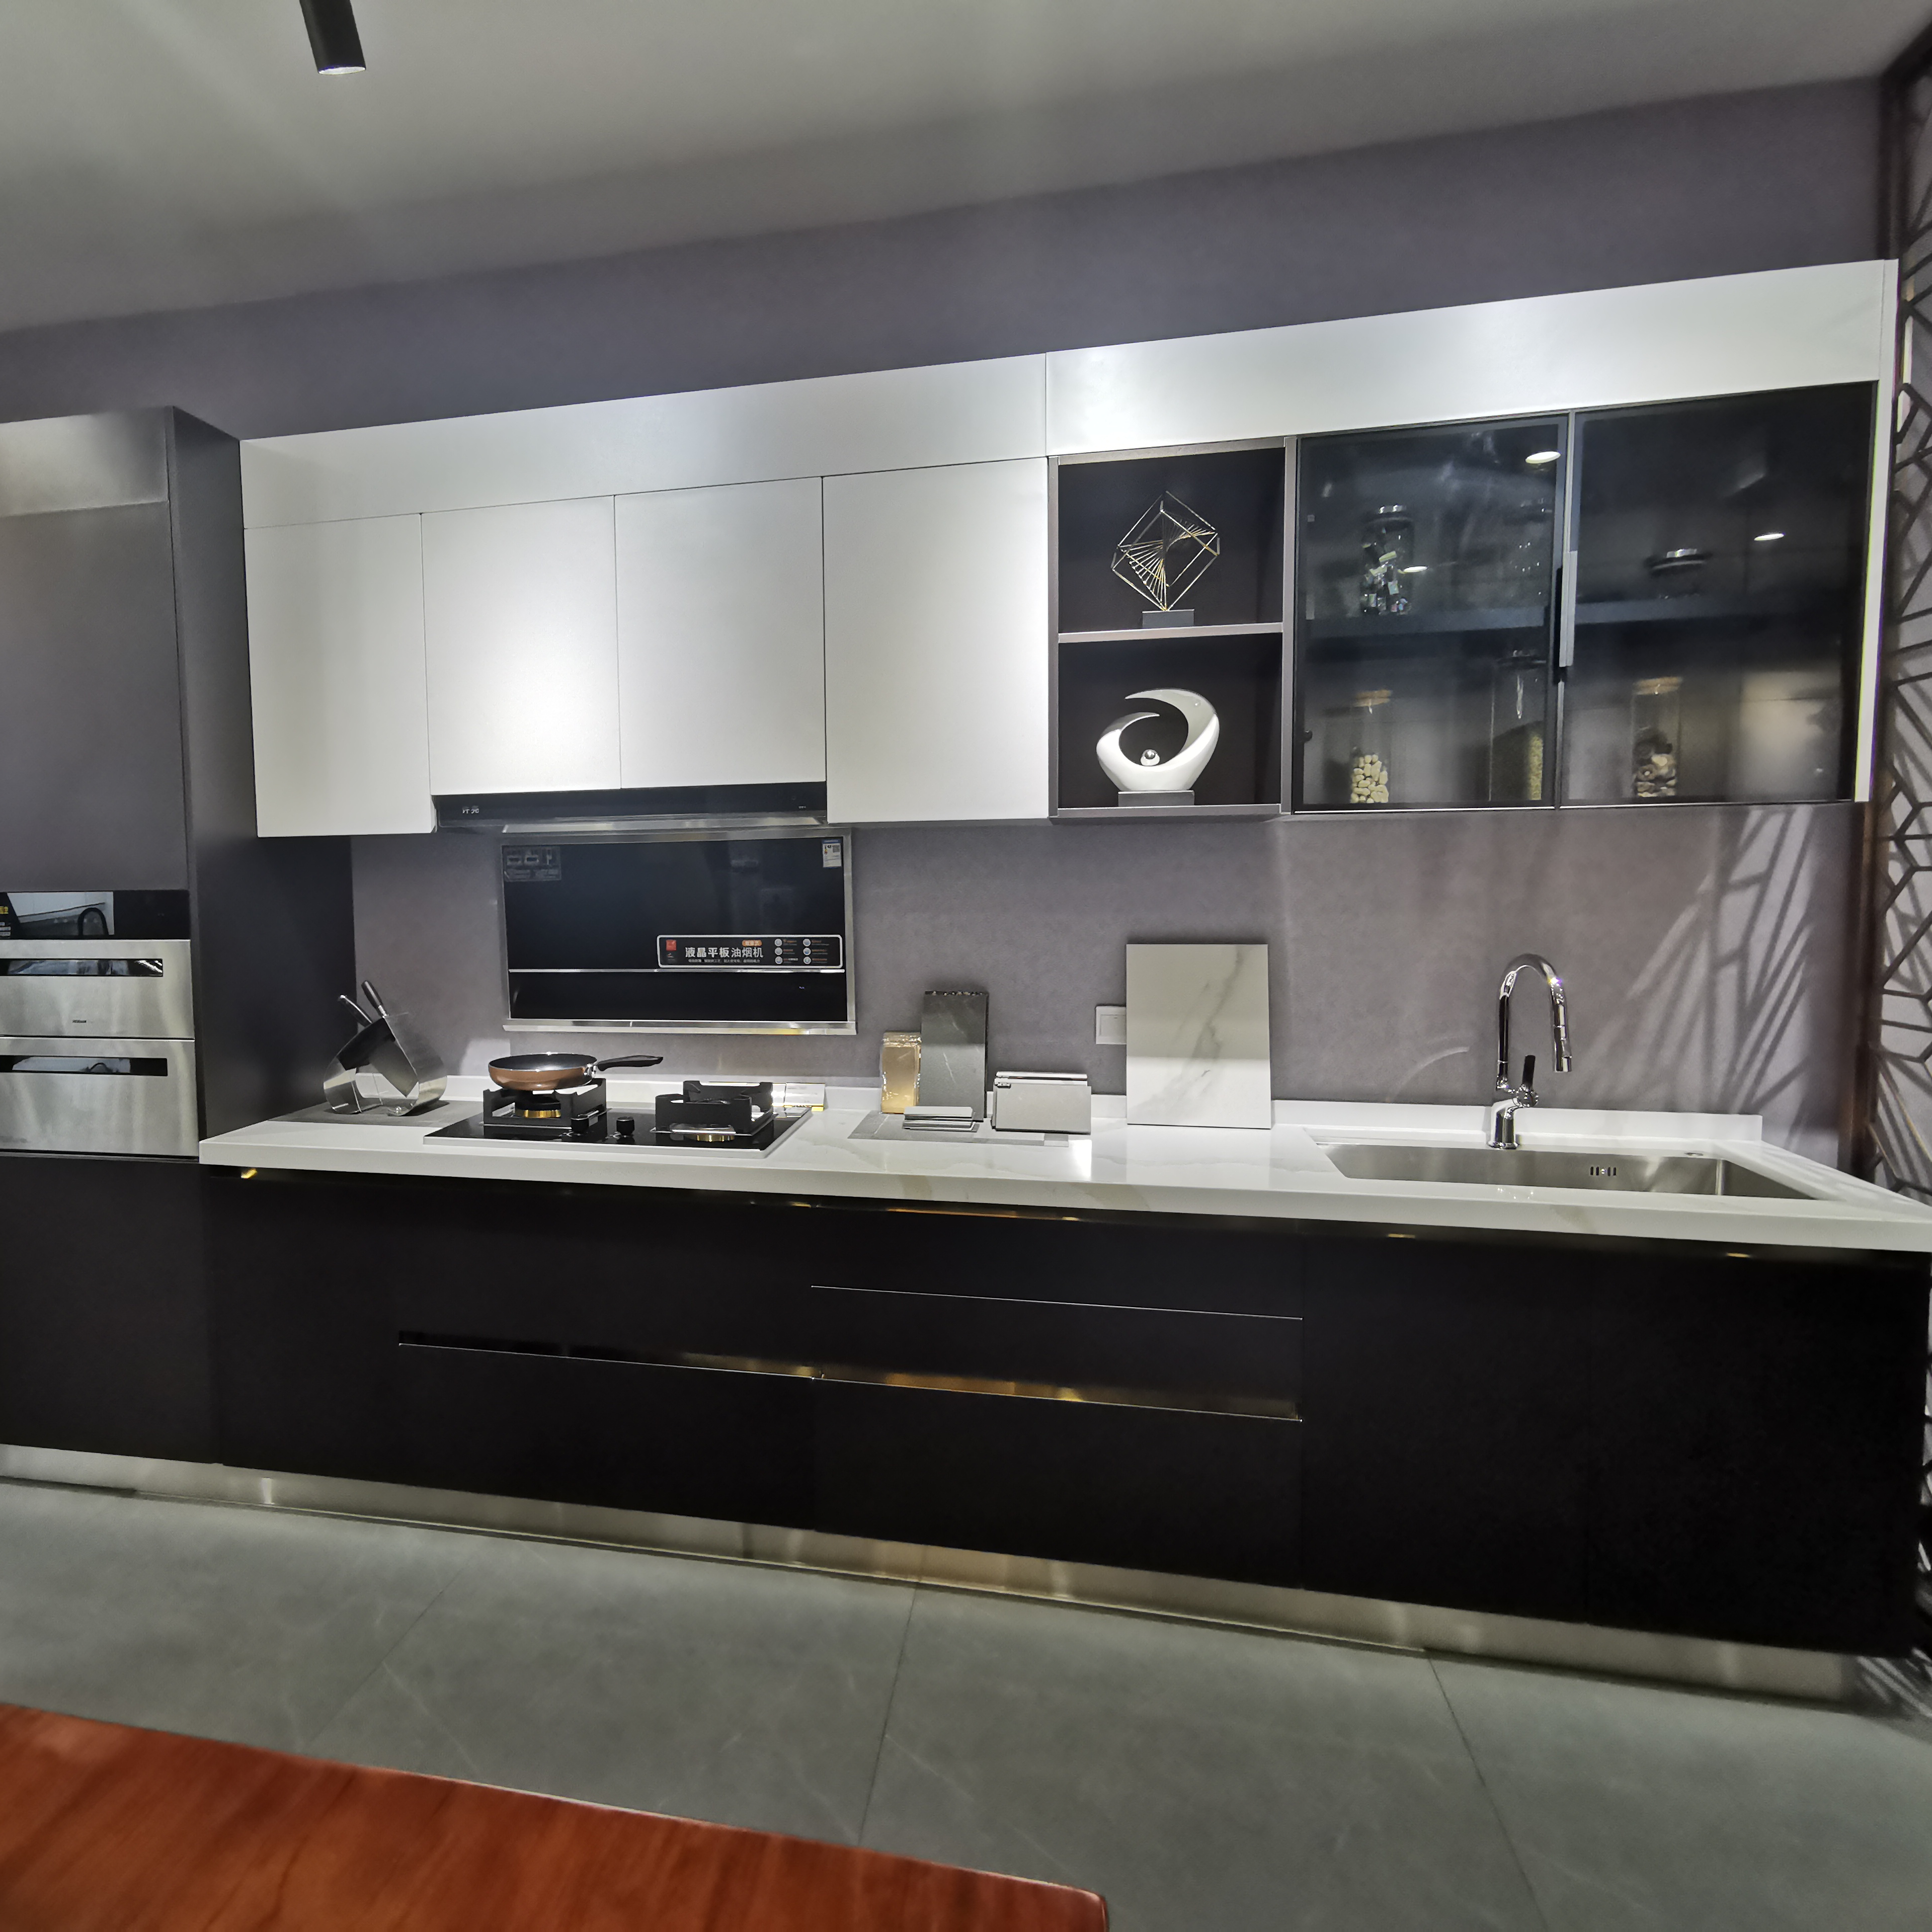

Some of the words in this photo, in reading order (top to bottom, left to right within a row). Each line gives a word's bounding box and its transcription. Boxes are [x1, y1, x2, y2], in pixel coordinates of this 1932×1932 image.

[685, 947, 764, 958] 液晶平板油烟机
